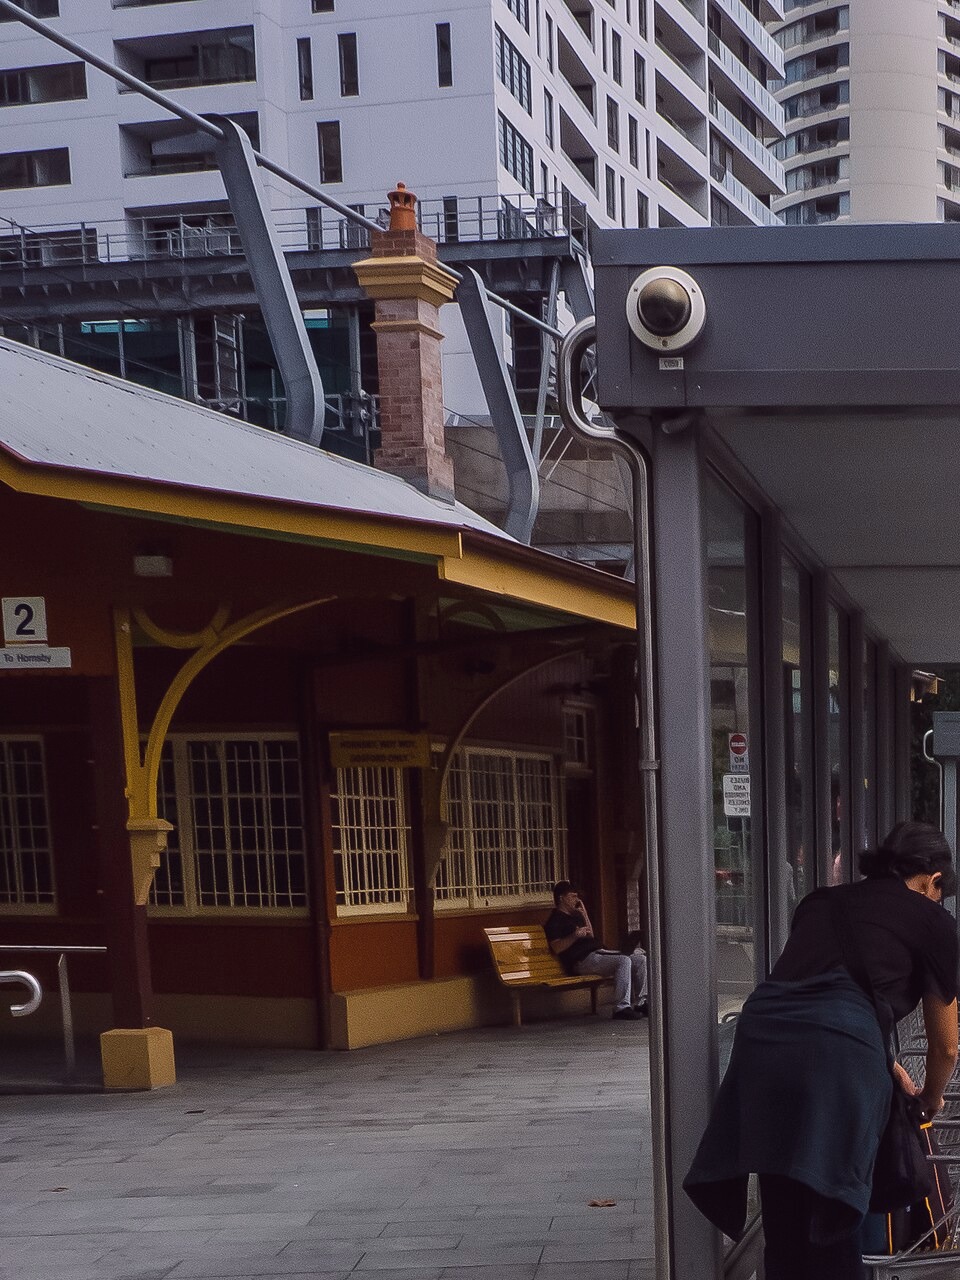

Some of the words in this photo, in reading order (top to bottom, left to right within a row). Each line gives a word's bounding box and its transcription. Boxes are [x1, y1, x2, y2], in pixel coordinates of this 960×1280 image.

[14, 603, 35, 635] 2
[3, 653, 14, 663] To
[16, 652, 51, 664] Hornsby
